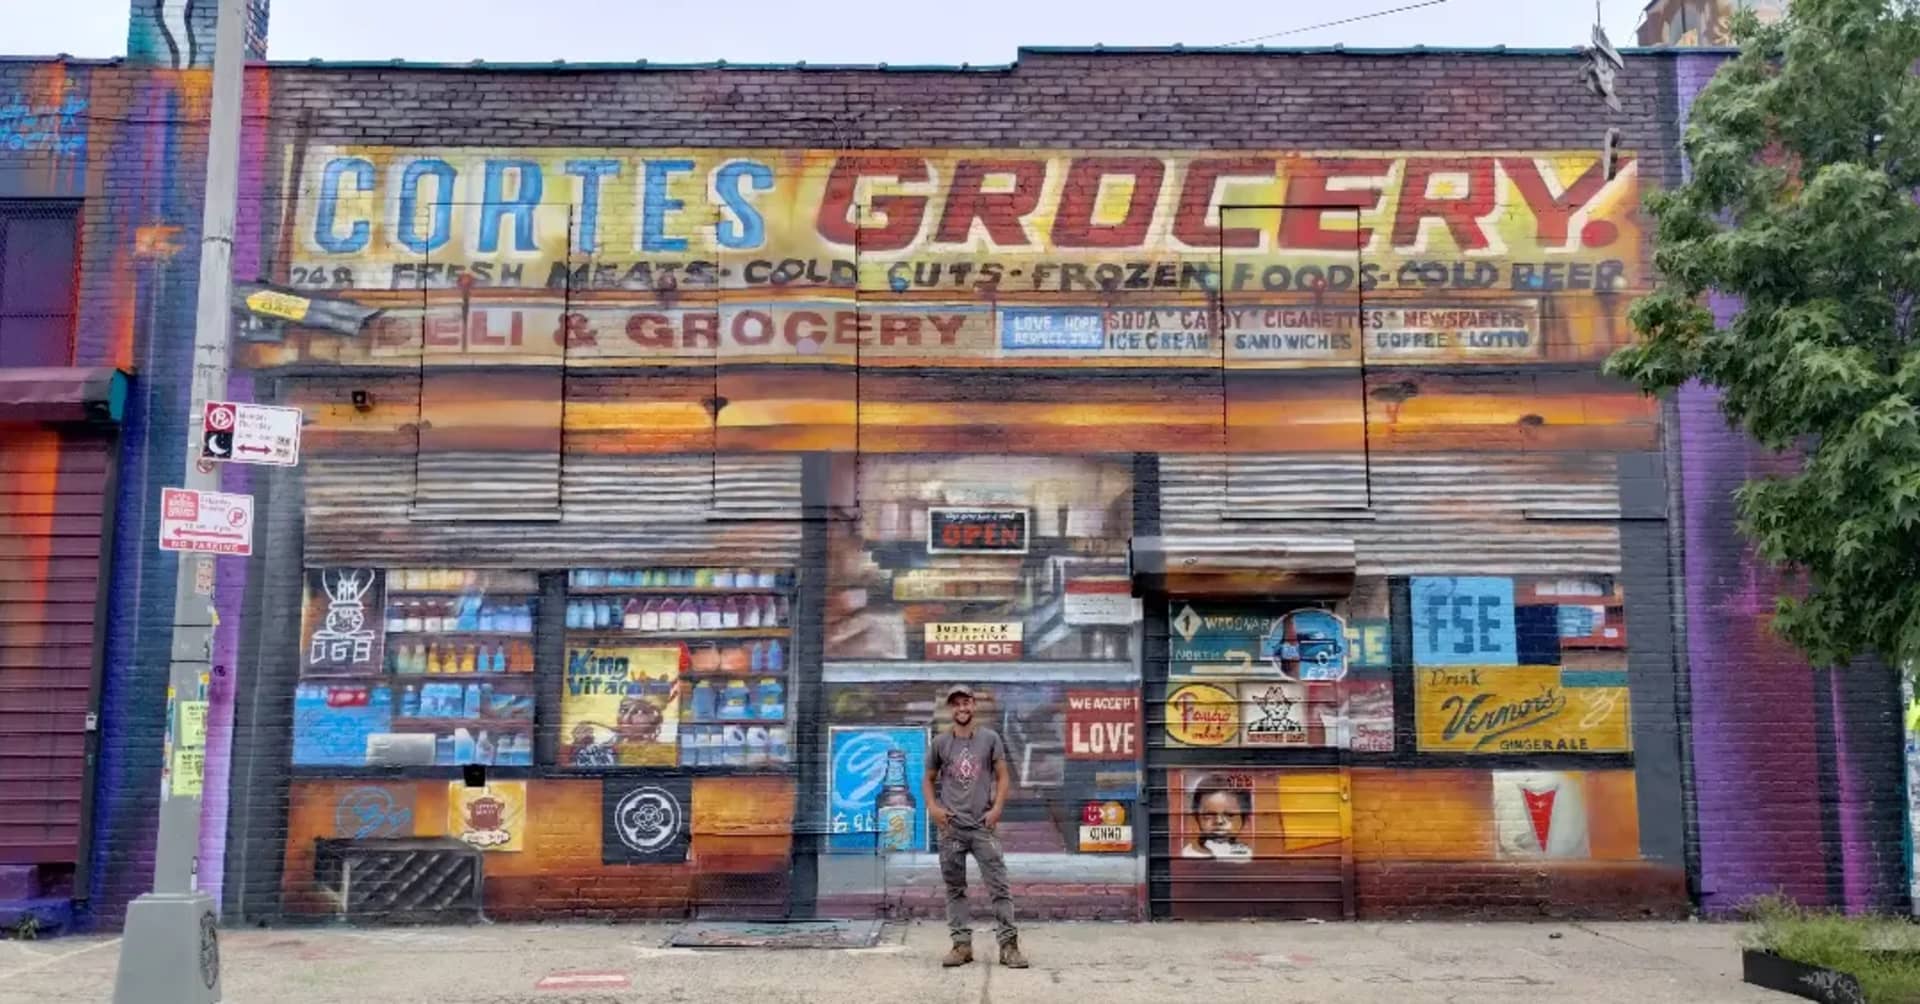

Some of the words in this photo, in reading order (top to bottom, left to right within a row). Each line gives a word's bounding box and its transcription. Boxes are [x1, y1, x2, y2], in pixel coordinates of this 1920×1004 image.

[314, 157, 775, 254] CORTES
[391, 262, 523, 289] FRESH
[1032, 261, 1218, 291] FROZEN
[1511, 260, 1629, 290] BEER
[373, 309, 523, 348] DELI
[552, 313, 598, 349] &
[625, 310, 967, 348] GROCERY
[1110, 311, 1161, 330] SODA
[1181, 311, 1242, 330] CADY
[1403, 310, 1525, 329] NEWSPAPERS
[1110, 333, 1140, 349] ICE
[1144, 332, 1209, 350] CREAM
[1235, 333, 1353, 350] SANDWICHES
[1376, 332, 1449, 349] COFFEE
[1468, 330, 1530, 348] LOTTO
[942, 522, 1018, 546] OPEN
[936, 643, 1014, 656] INSIDE
[569, 649, 629, 680] King
[1429, 668, 1481, 687] Drink
[1070, 697, 1091, 710] WE
[1093, 697, 1139, 710] ACCEPT
[1072, 721, 1136, 755] LOVE
